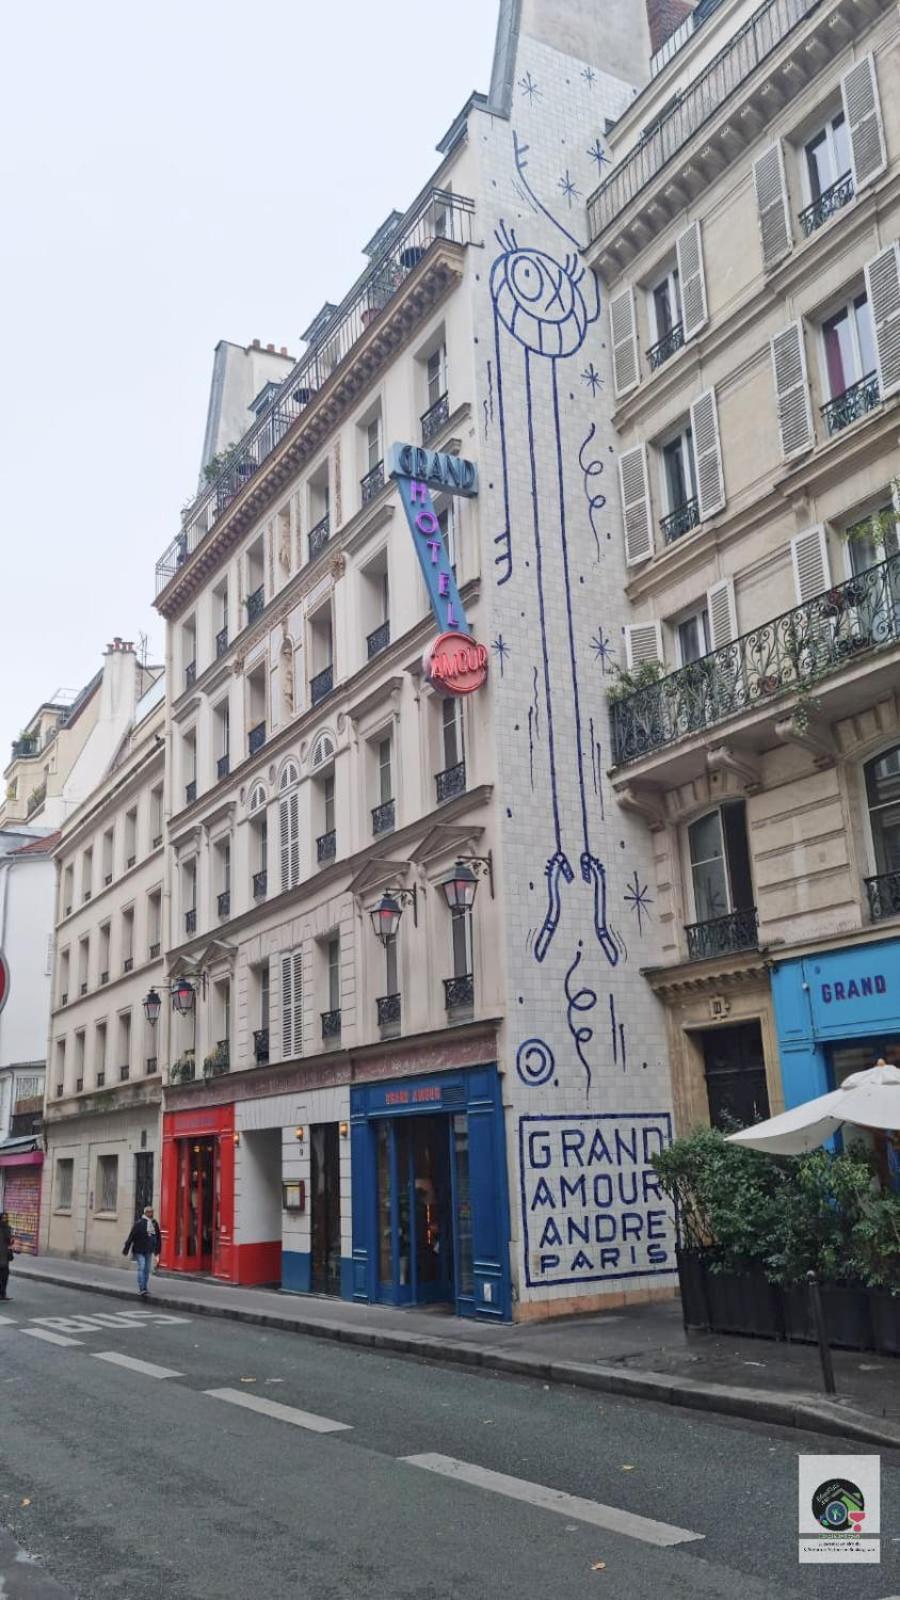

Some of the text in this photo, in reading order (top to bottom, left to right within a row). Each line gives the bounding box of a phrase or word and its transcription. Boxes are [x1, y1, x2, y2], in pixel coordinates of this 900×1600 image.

[400, 445, 475, 489] GRAND
[410, 480, 459, 627] HOTEL
[431, 644, 487, 680] AMOUR
[821, 974, 887, 1004] GRAND
[528, 1126, 664, 1169] GRAND
[531, 1169, 663, 1211] AMOUR
[539, 1210, 667, 1249] ANDRE
[540, 1244, 668, 1274] PARIS
[27, 1310, 193, 1334] BUS
